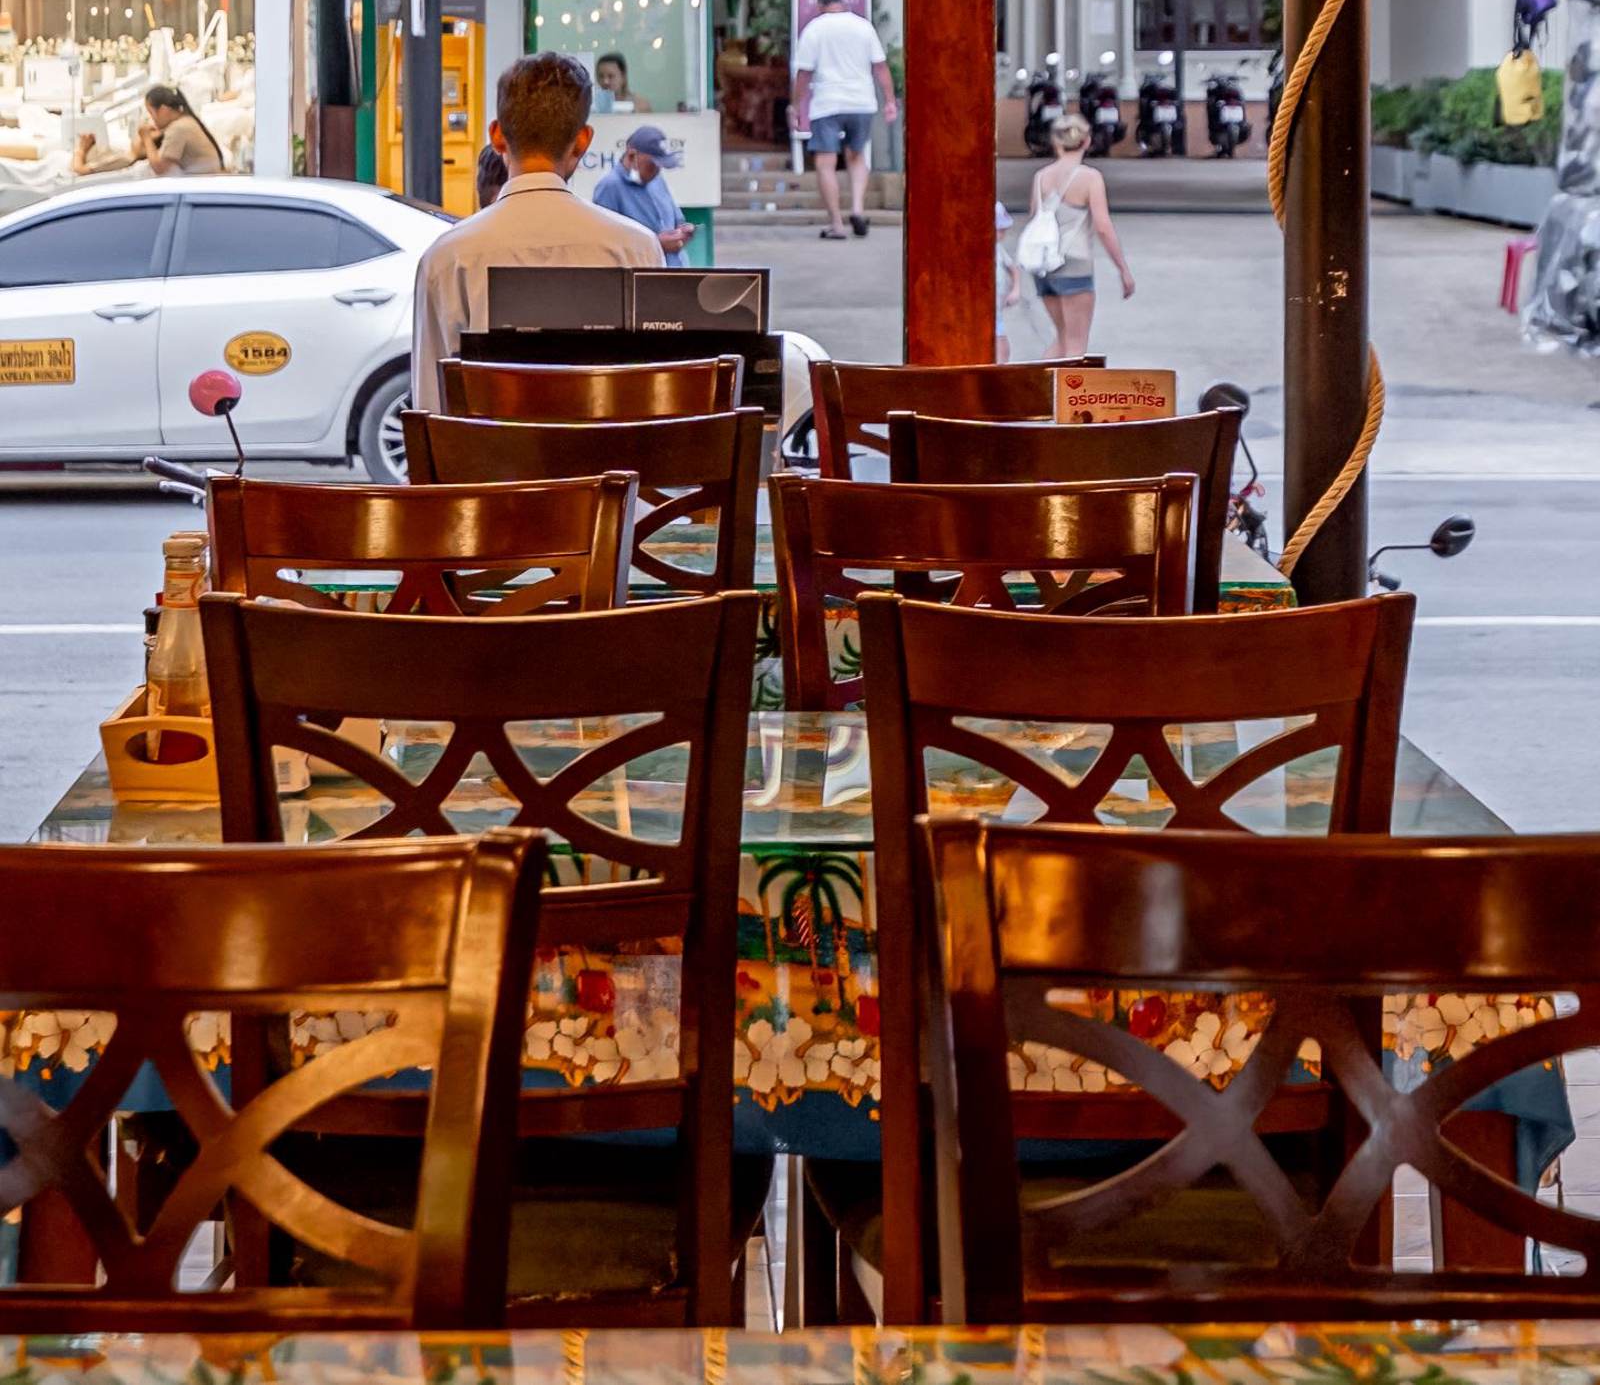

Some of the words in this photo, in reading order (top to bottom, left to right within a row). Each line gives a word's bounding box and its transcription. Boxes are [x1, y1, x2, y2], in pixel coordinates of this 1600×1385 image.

[642, 321, 683, 331] PATONG
[1068, 388, 1166, 408] อร่อยหลากรส
